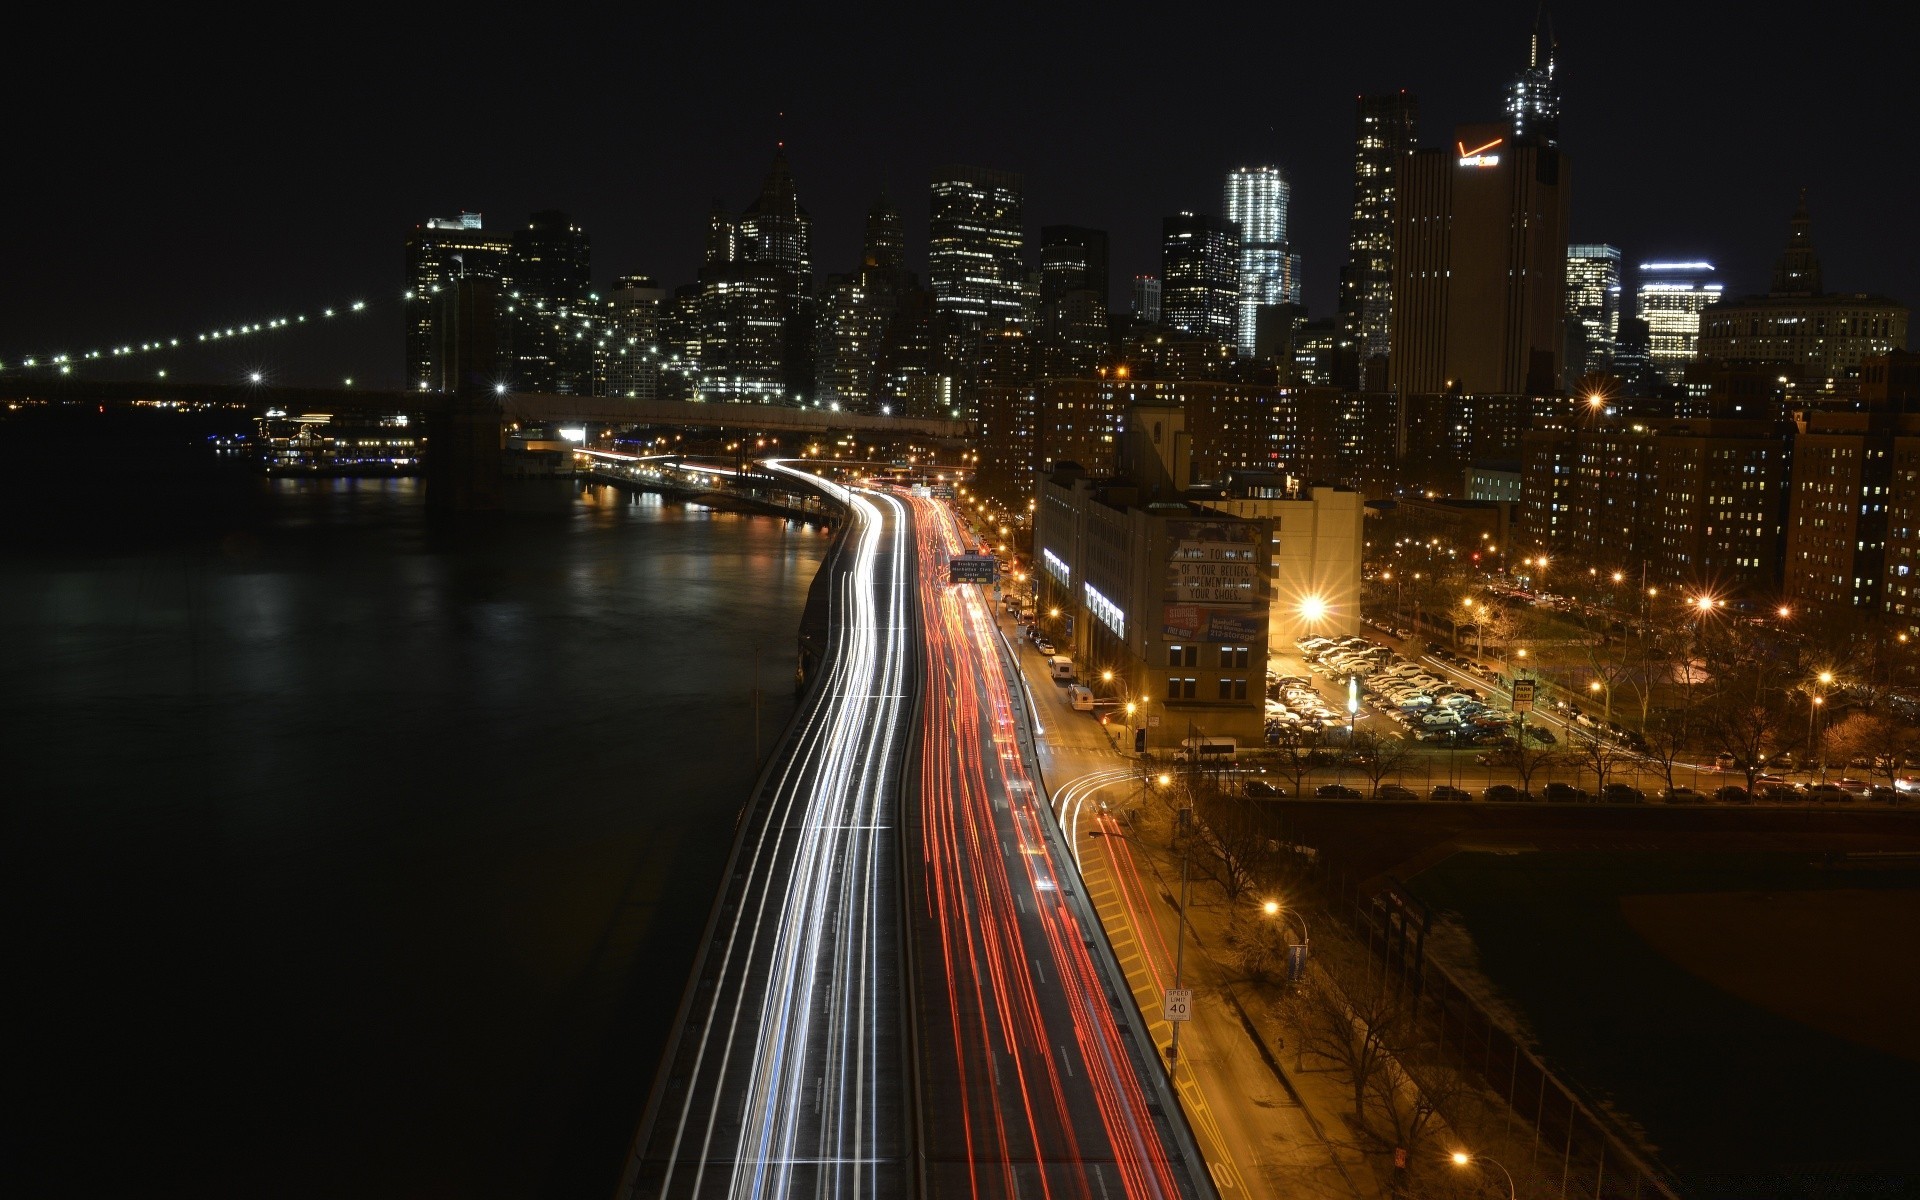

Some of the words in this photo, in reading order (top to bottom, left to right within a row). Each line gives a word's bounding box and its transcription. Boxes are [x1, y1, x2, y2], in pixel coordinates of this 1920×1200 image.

[1209, 548, 1250, 560] TOLERANT
[1181, 563, 1190, 574] OF
[1195, 564, 1216, 576] YOUR
[1220, 565, 1252, 577] BELIEFS.
[1182, 576, 1235, 588] JUDGEMENTAL
[1241, 578, 1251, 589] OF
[1189, 589, 1209, 600] YOUR
[1214, 589, 1242, 600] SHOES.
[1169, 607, 1198, 618] STORAGE
[1170, 1003, 1186, 1013] 40
